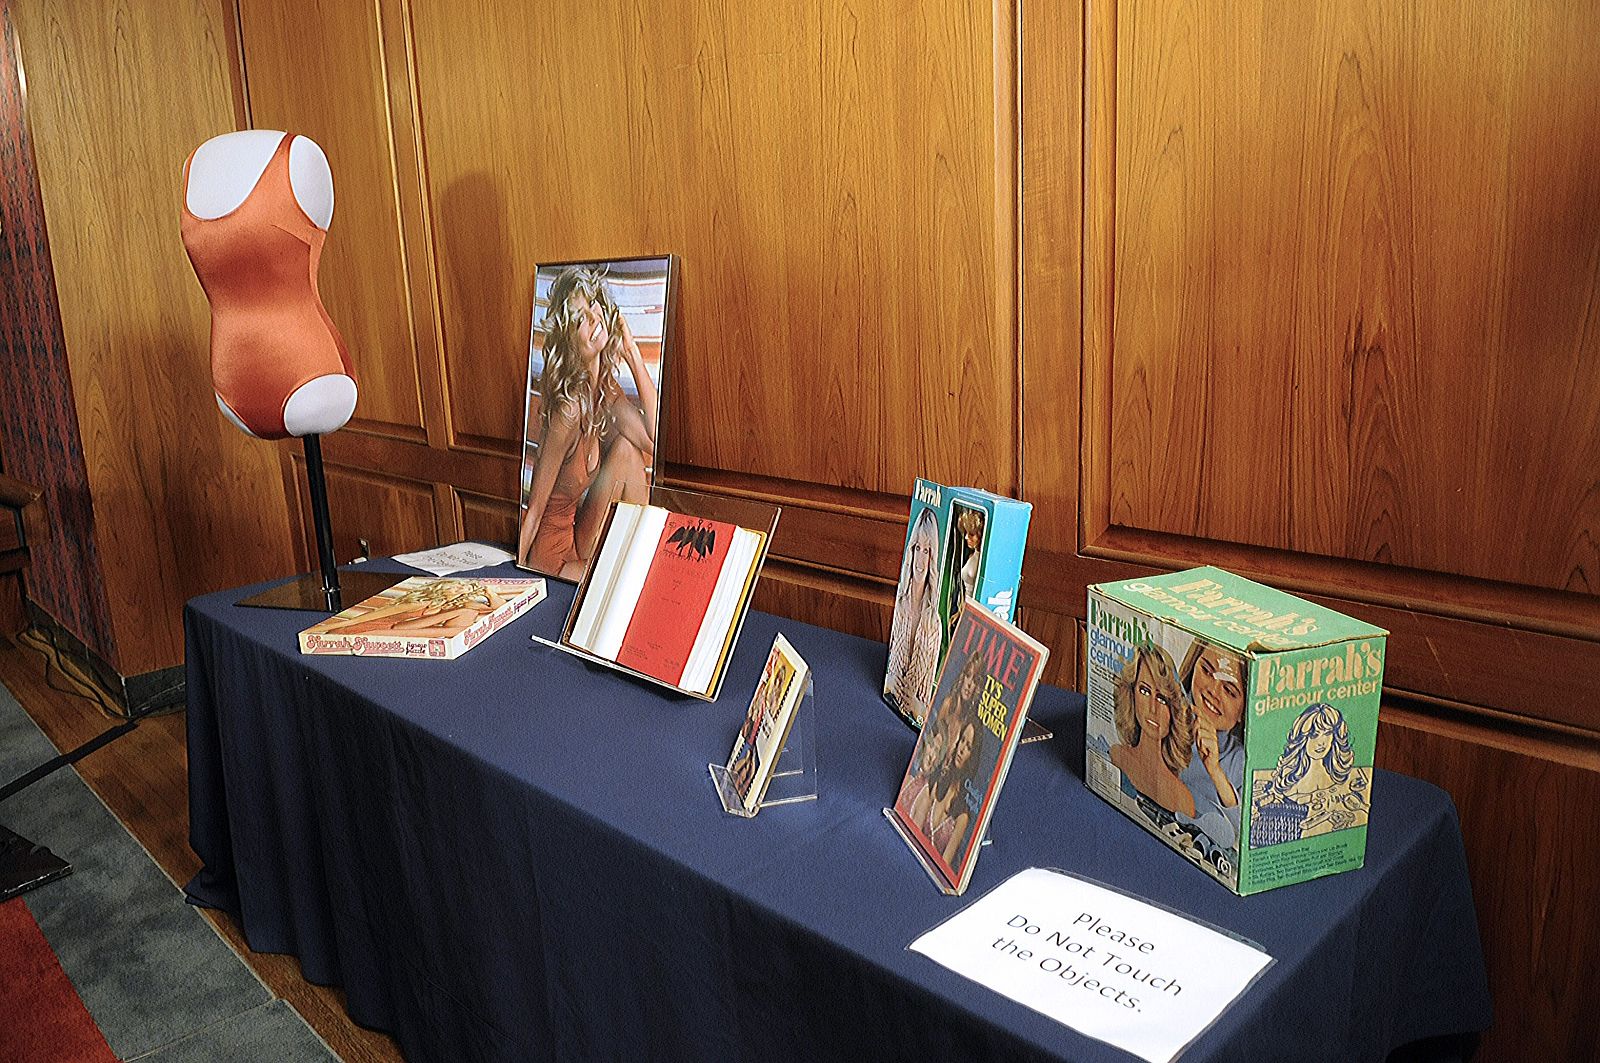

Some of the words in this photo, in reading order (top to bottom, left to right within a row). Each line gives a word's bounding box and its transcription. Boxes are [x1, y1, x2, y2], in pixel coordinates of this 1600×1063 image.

[914, 479, 941, 508] Farrah
[1123, 582, 1218, 621] glamour
[1168, 578, 1319, 635] Farrah's
[307, 635, 352, 653] Farrah
[1090, 597, 1155, 651] Farrah's
[963, 616, 1025, 692] TIME
[1255, 641, 1382, 697] Farrah's
[980, 690, 1007, 723] SUPER
[984, 674, 1003, 700] TV'S
[1255, 689, 1324, 716] glamour
[1327, 679, 1379, 700] center
[977, 703, 1007, 742] WOMEN
[1072, 912, 1155, 955] Please
[992, 936, 1033, 961] the
[1039, 957, 1142, 1012] Objects.
[1006, 914, 1041, 935] Do
[1046, 931, 1096, 959] Not
[1102, 952, 1182, 996] Touch
